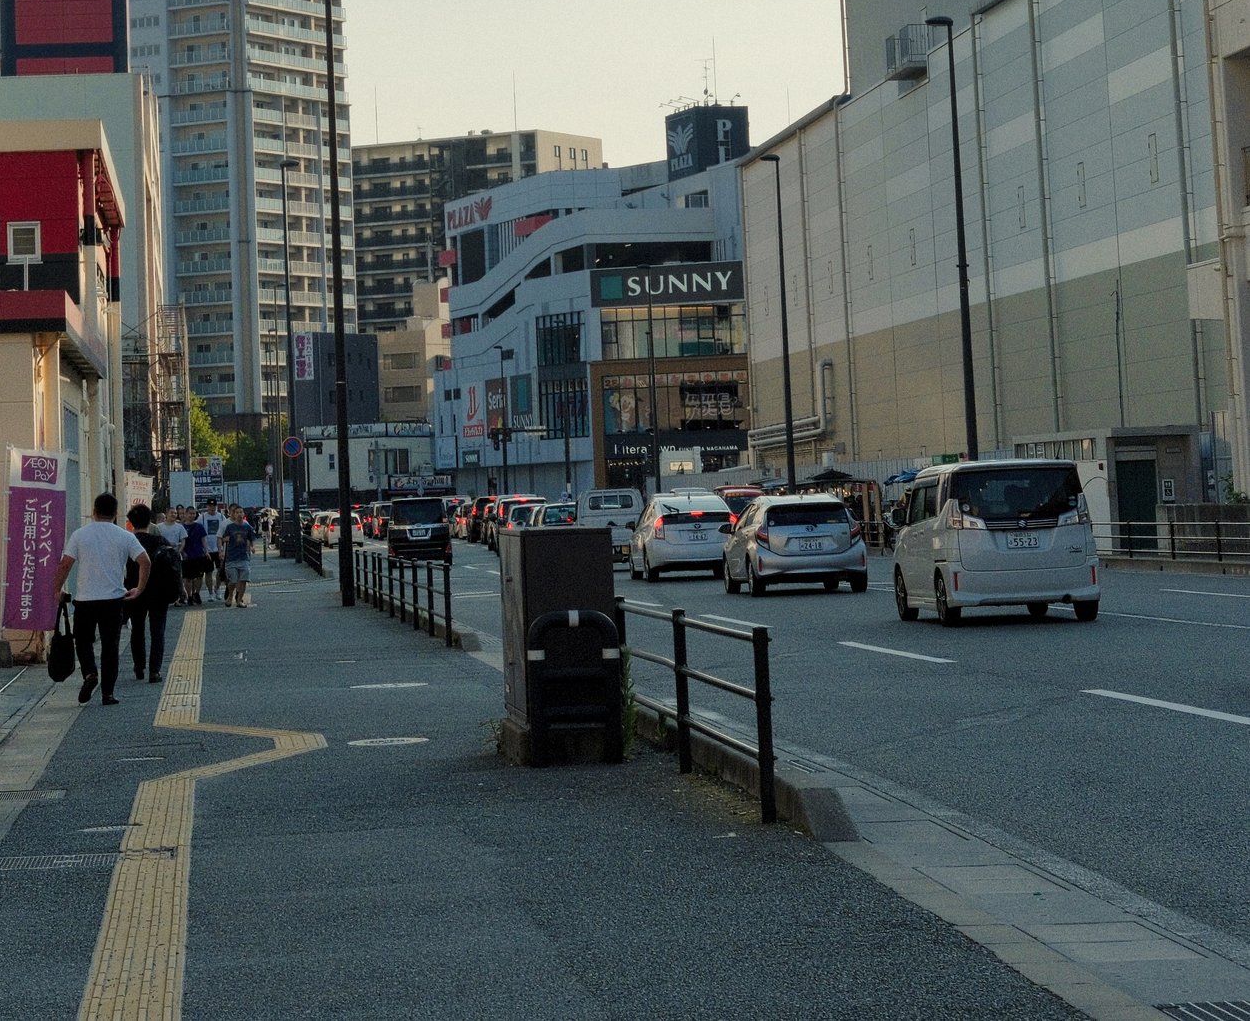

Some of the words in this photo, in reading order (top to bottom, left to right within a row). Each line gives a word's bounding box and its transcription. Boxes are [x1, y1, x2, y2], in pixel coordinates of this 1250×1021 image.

[446, 203, 476, 231] PLAZA
[627, 270, 733, 297] SUNNY
[513, 413, 534, 429] SUNNY
[38, 500, 53, 567] イオンペイ
[20, 497, 38, 620] ご利用いただけます
